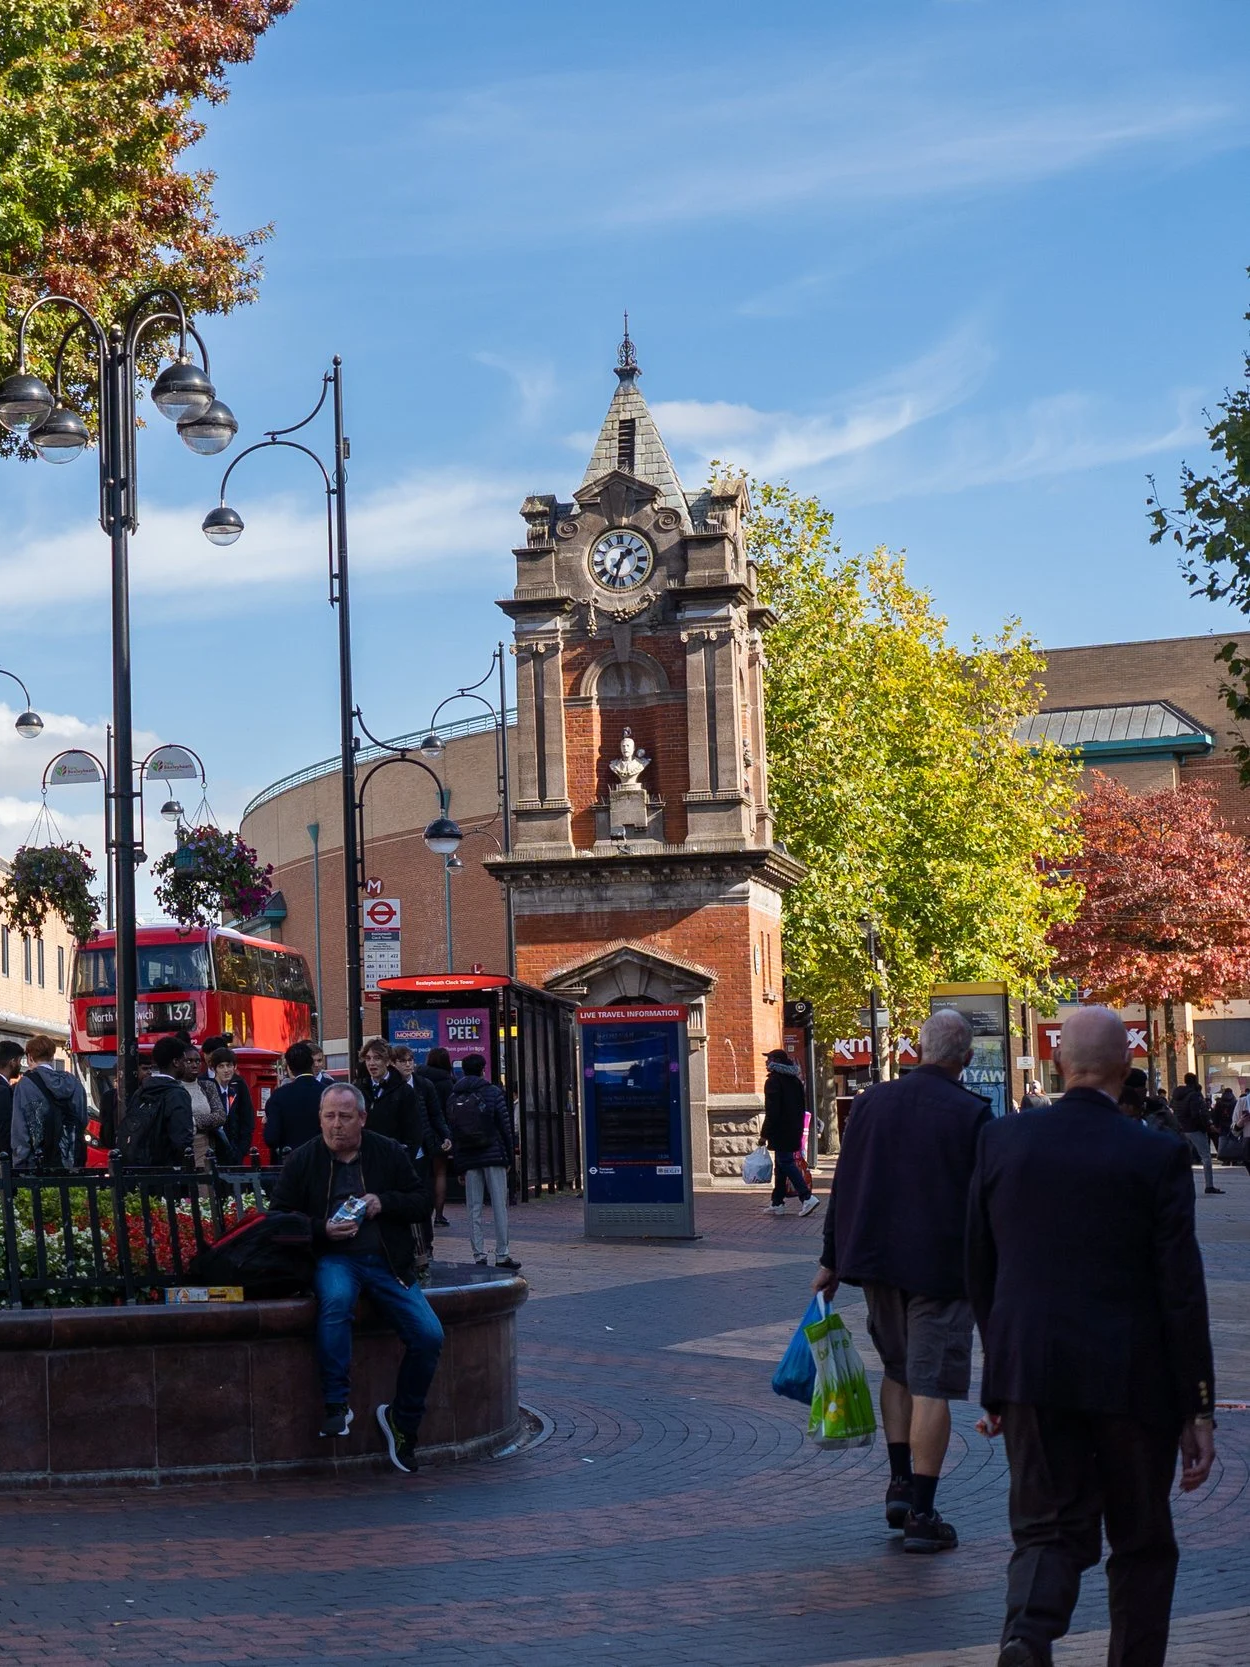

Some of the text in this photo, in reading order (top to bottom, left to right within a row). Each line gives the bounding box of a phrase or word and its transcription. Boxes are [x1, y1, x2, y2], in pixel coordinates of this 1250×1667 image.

[367, 879, 382, 894] M
[91, 1012, 113, 1023] North
[168, 1003, 191, 1021] 132
[626, 1009, 679, 1017] INFORMATION
[446, 1016, 481, 1025] Double
[448, 1026, 480, 1040] PEEL
